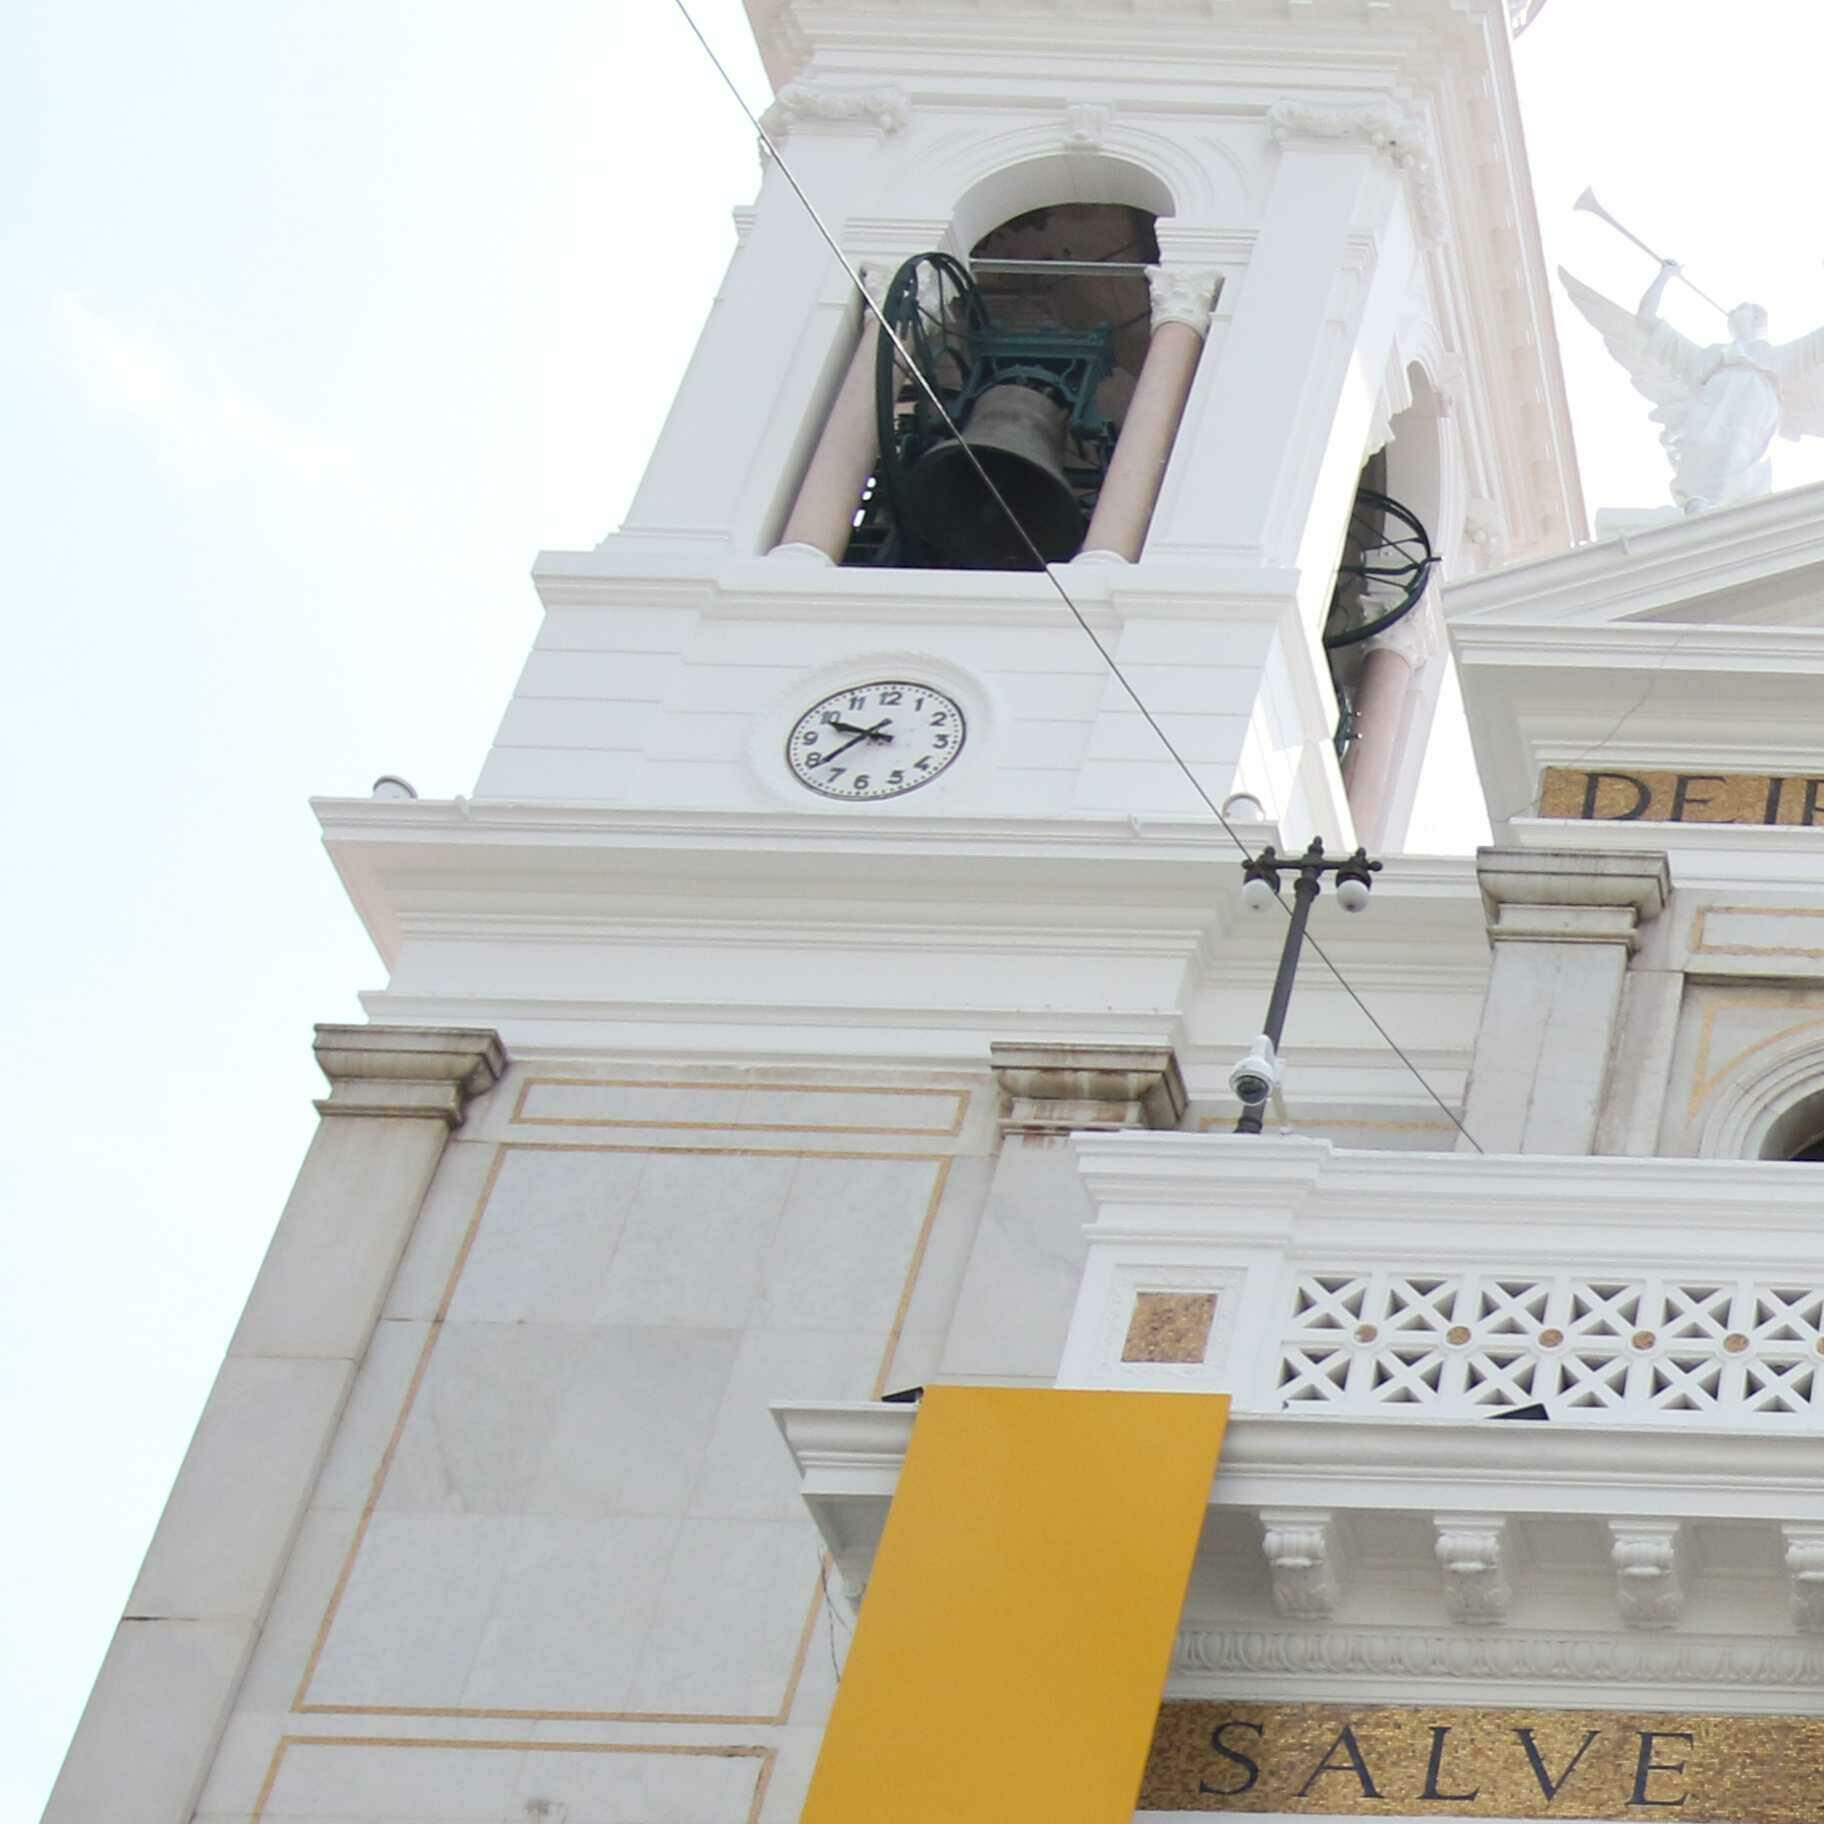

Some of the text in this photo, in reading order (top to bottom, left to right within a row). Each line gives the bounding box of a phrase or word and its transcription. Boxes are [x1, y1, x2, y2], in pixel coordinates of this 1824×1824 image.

[848, 696, 865, 710] 11
[879, 691, 902, 706] 12
[914, 698, 924, 711] 1
[930, 712, 947, 726] 2
[803, 731, 818, 746] 9
[933, 734, 950, 749] 3
[804, 752, 822, 768] 8
[914, 755, 934, 771] 4
[827, 768, 847, 783] 7
[853, 774, 870, 790] 6
[887, 770, 906, 785] 5
[1198, 1720, 1696, 1808] SALVE
